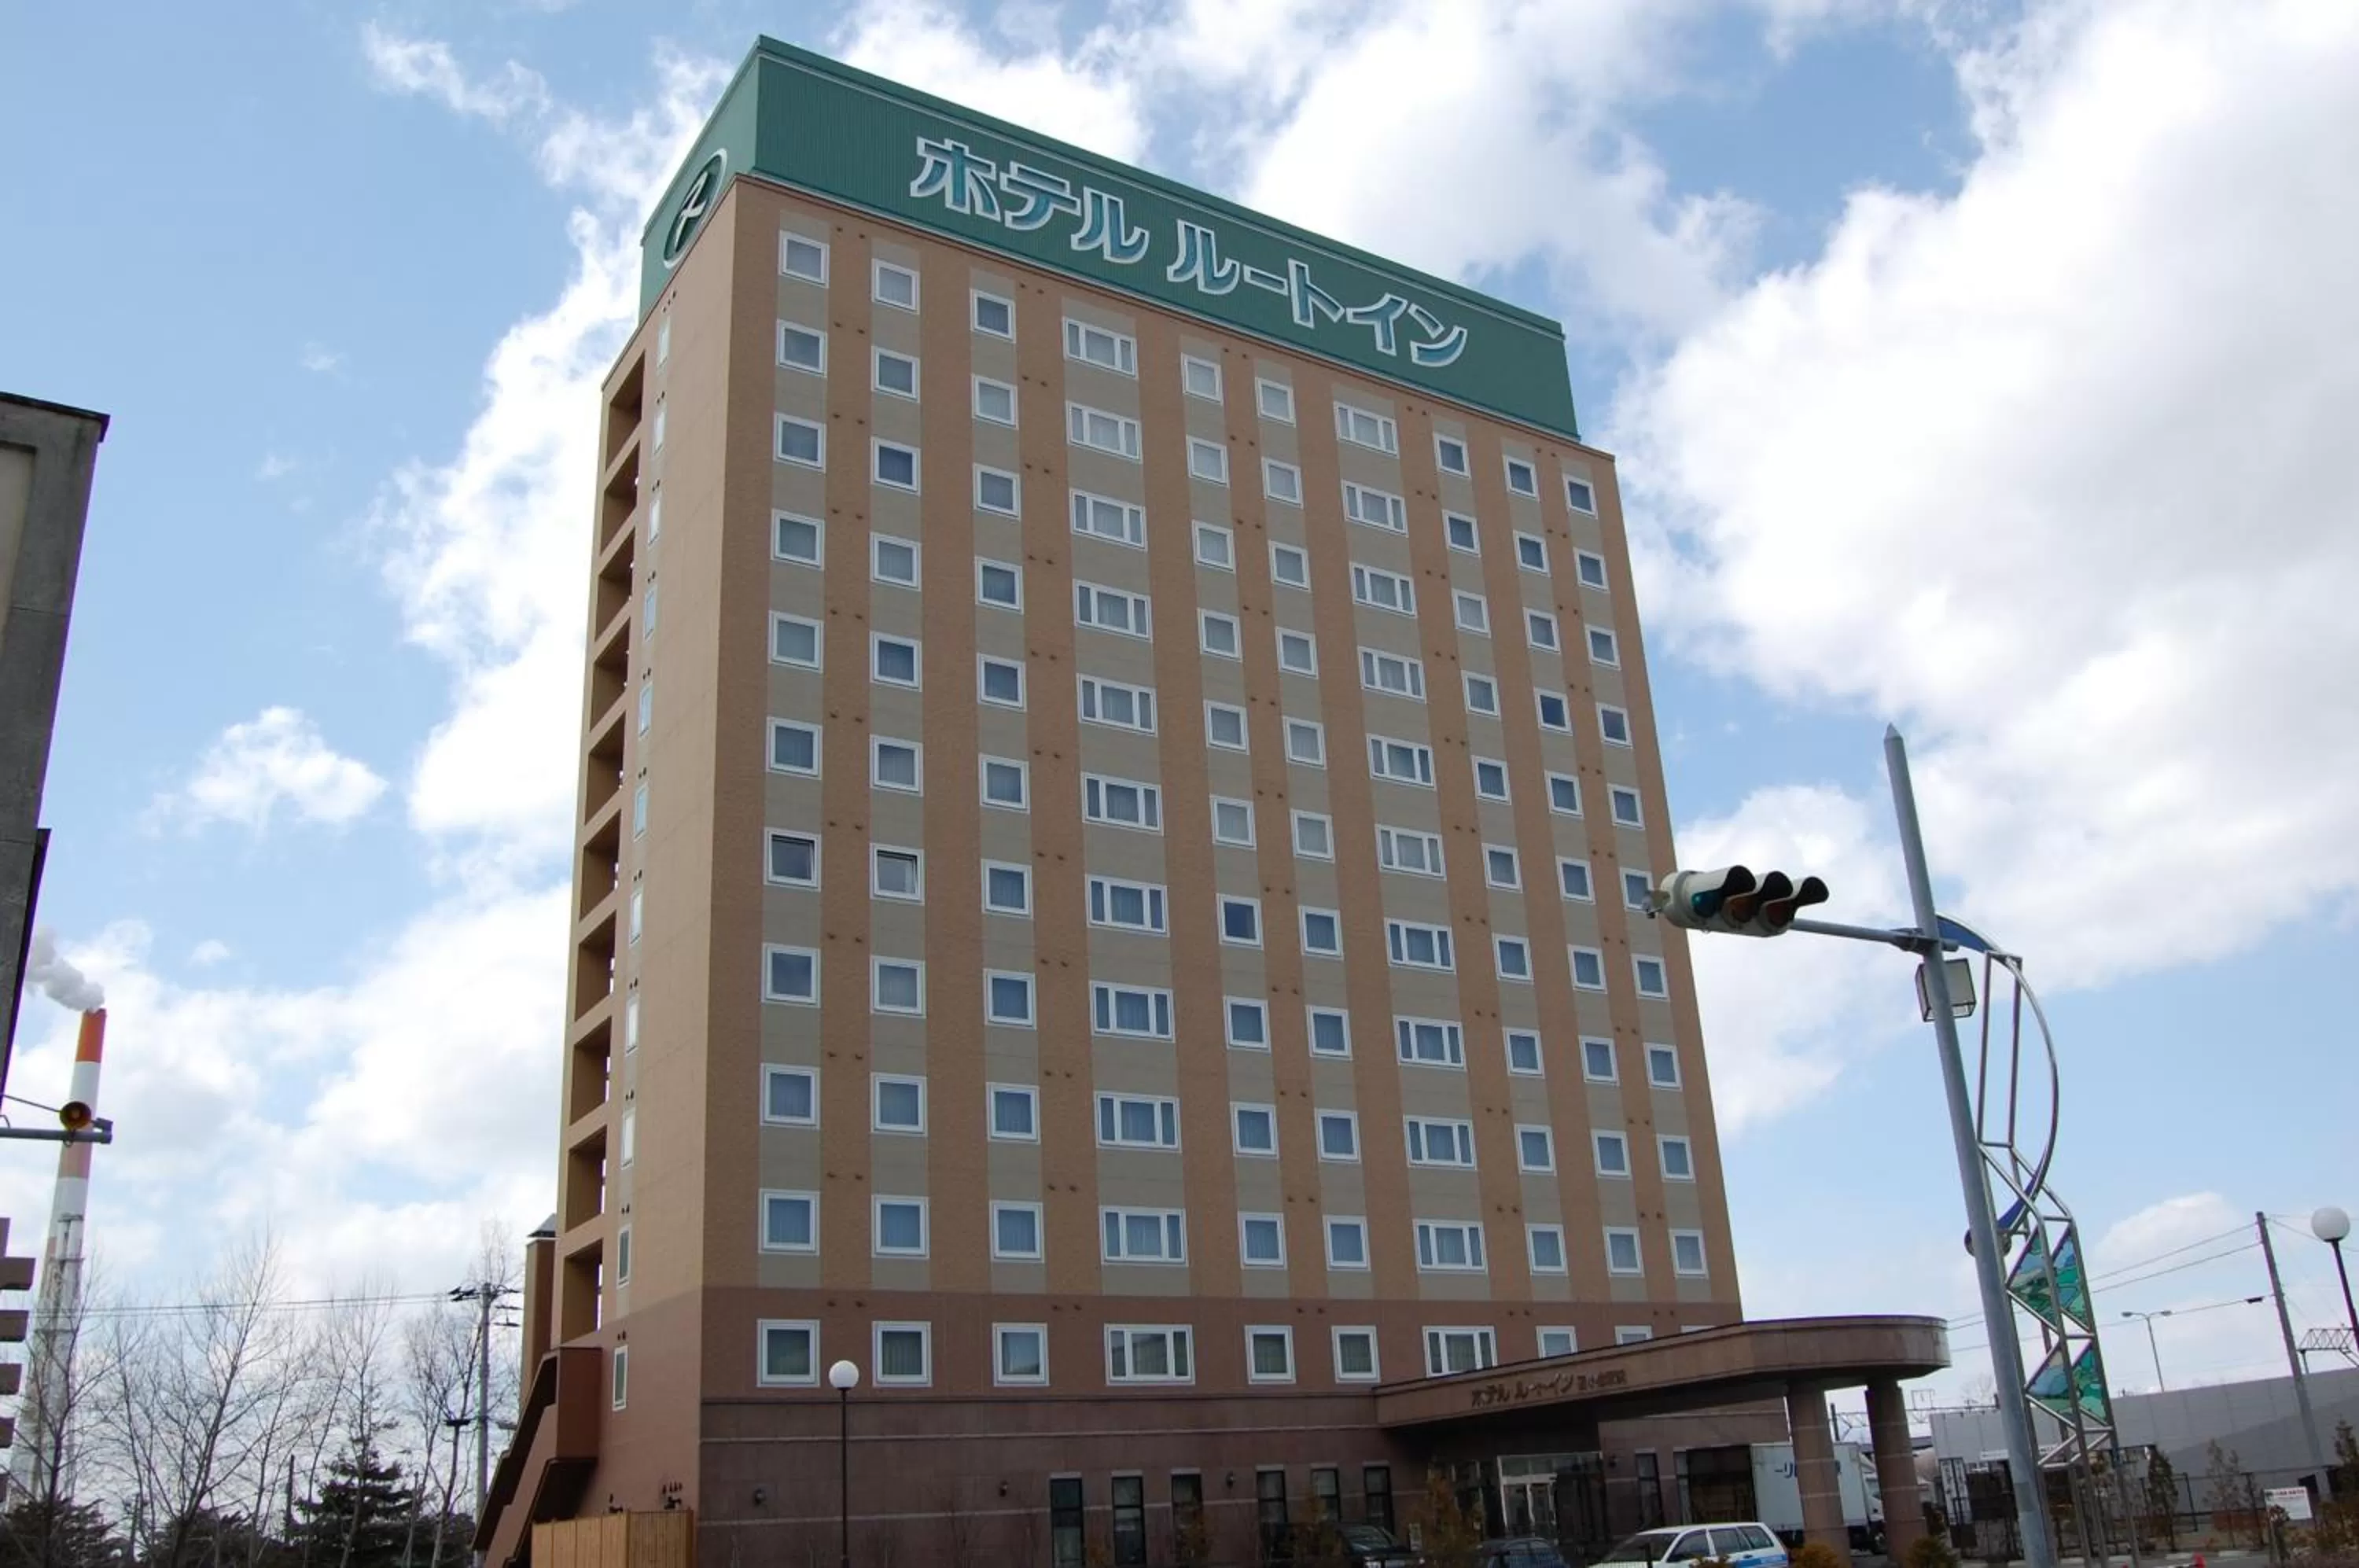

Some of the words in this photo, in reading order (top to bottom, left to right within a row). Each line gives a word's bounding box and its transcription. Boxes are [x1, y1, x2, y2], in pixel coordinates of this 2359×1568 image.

[910, 136, 1150, 264] ホテル
[1167, 219, 1467, 366] ルートイン
[1471, 1383, 1511, 1408] ホテル
